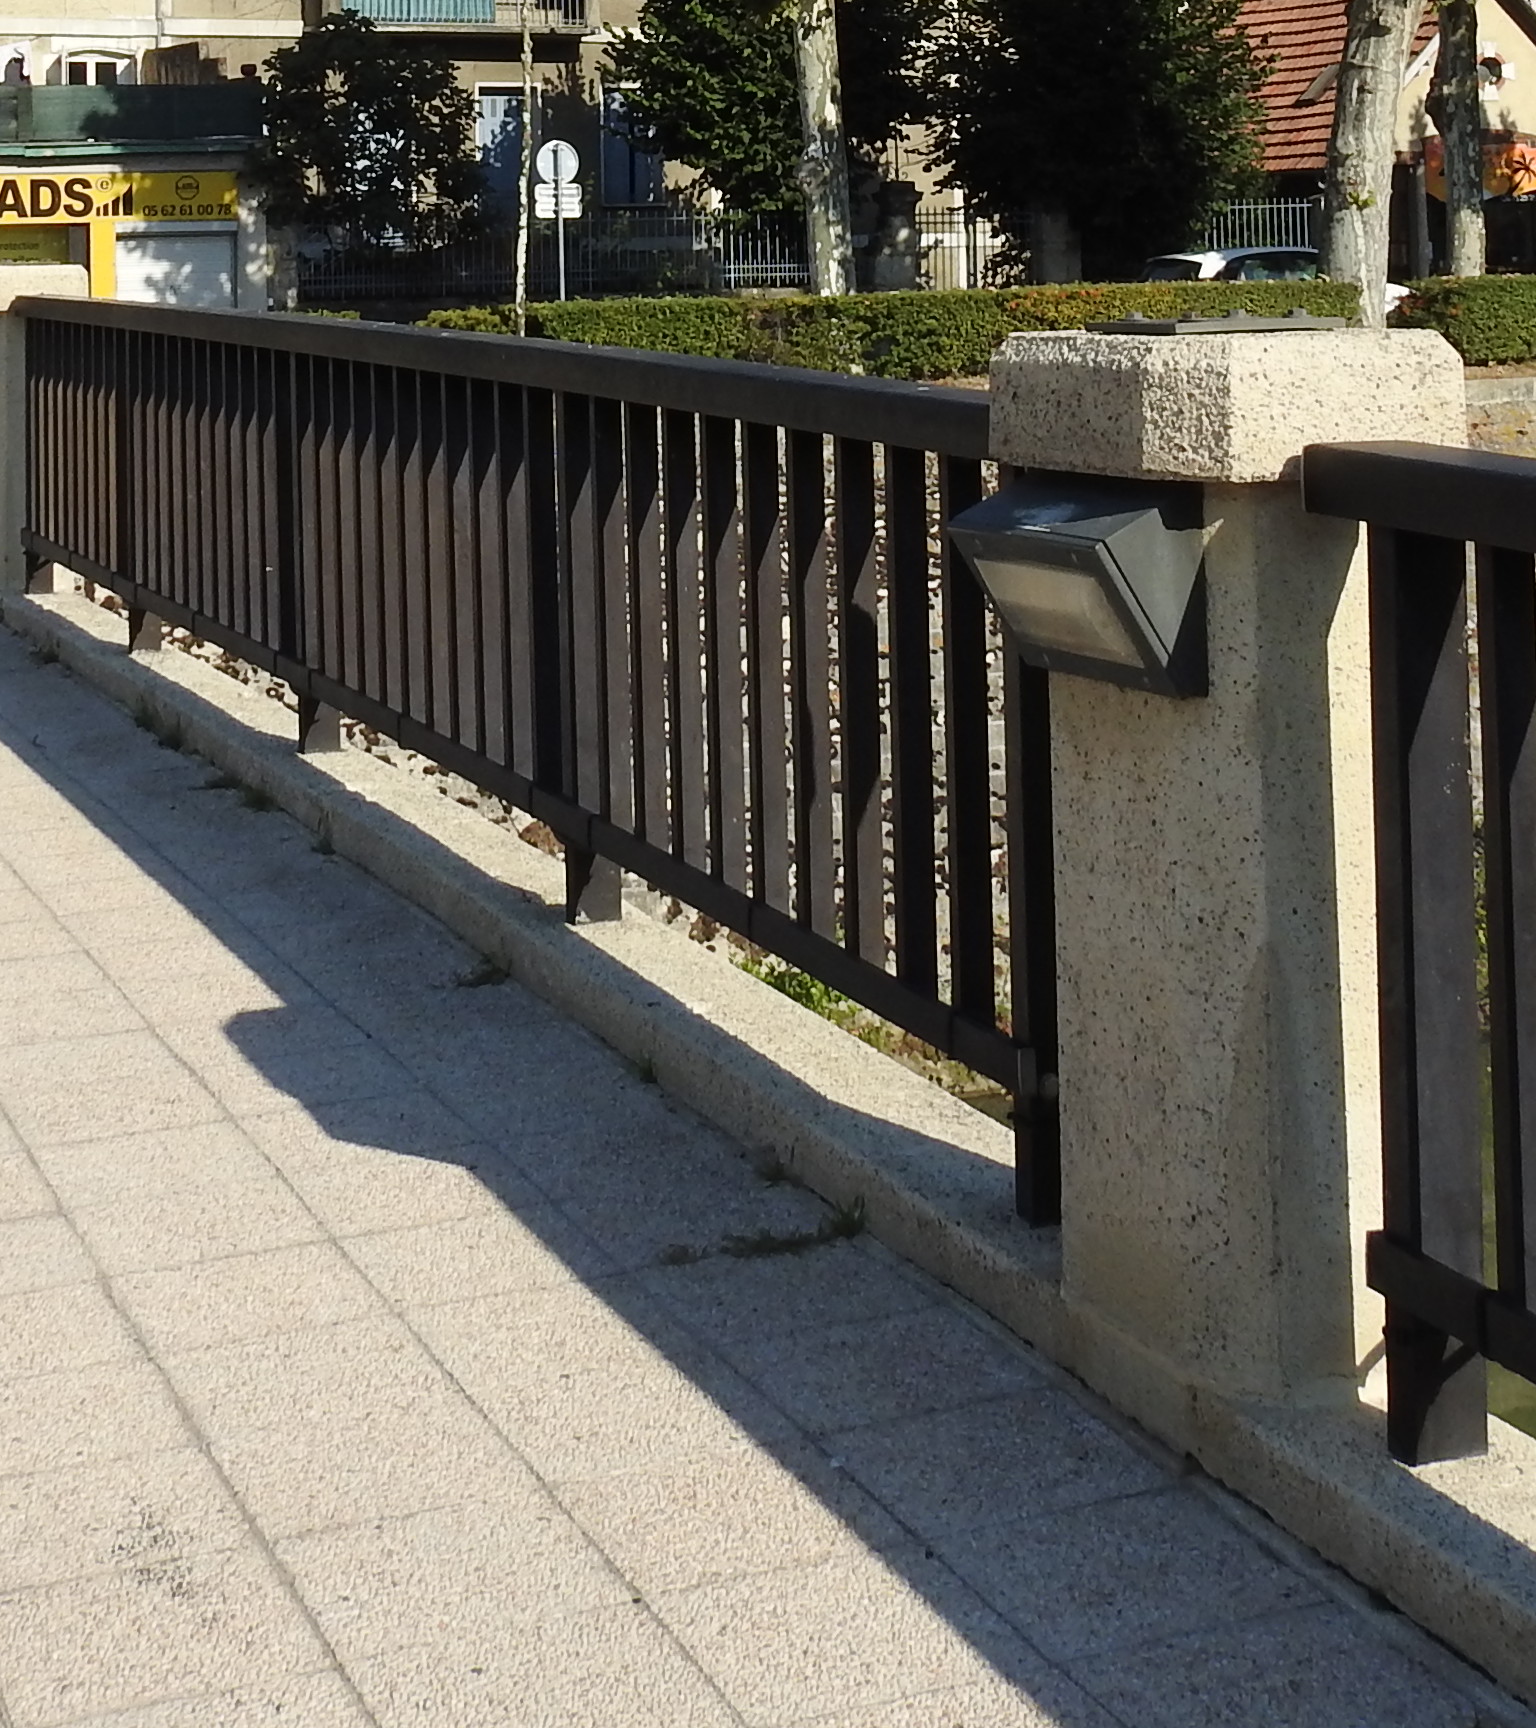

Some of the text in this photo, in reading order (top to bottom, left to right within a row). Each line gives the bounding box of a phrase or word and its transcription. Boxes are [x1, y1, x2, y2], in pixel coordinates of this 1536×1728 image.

[142, 203, 232, 217] 05 62 61 00 78
